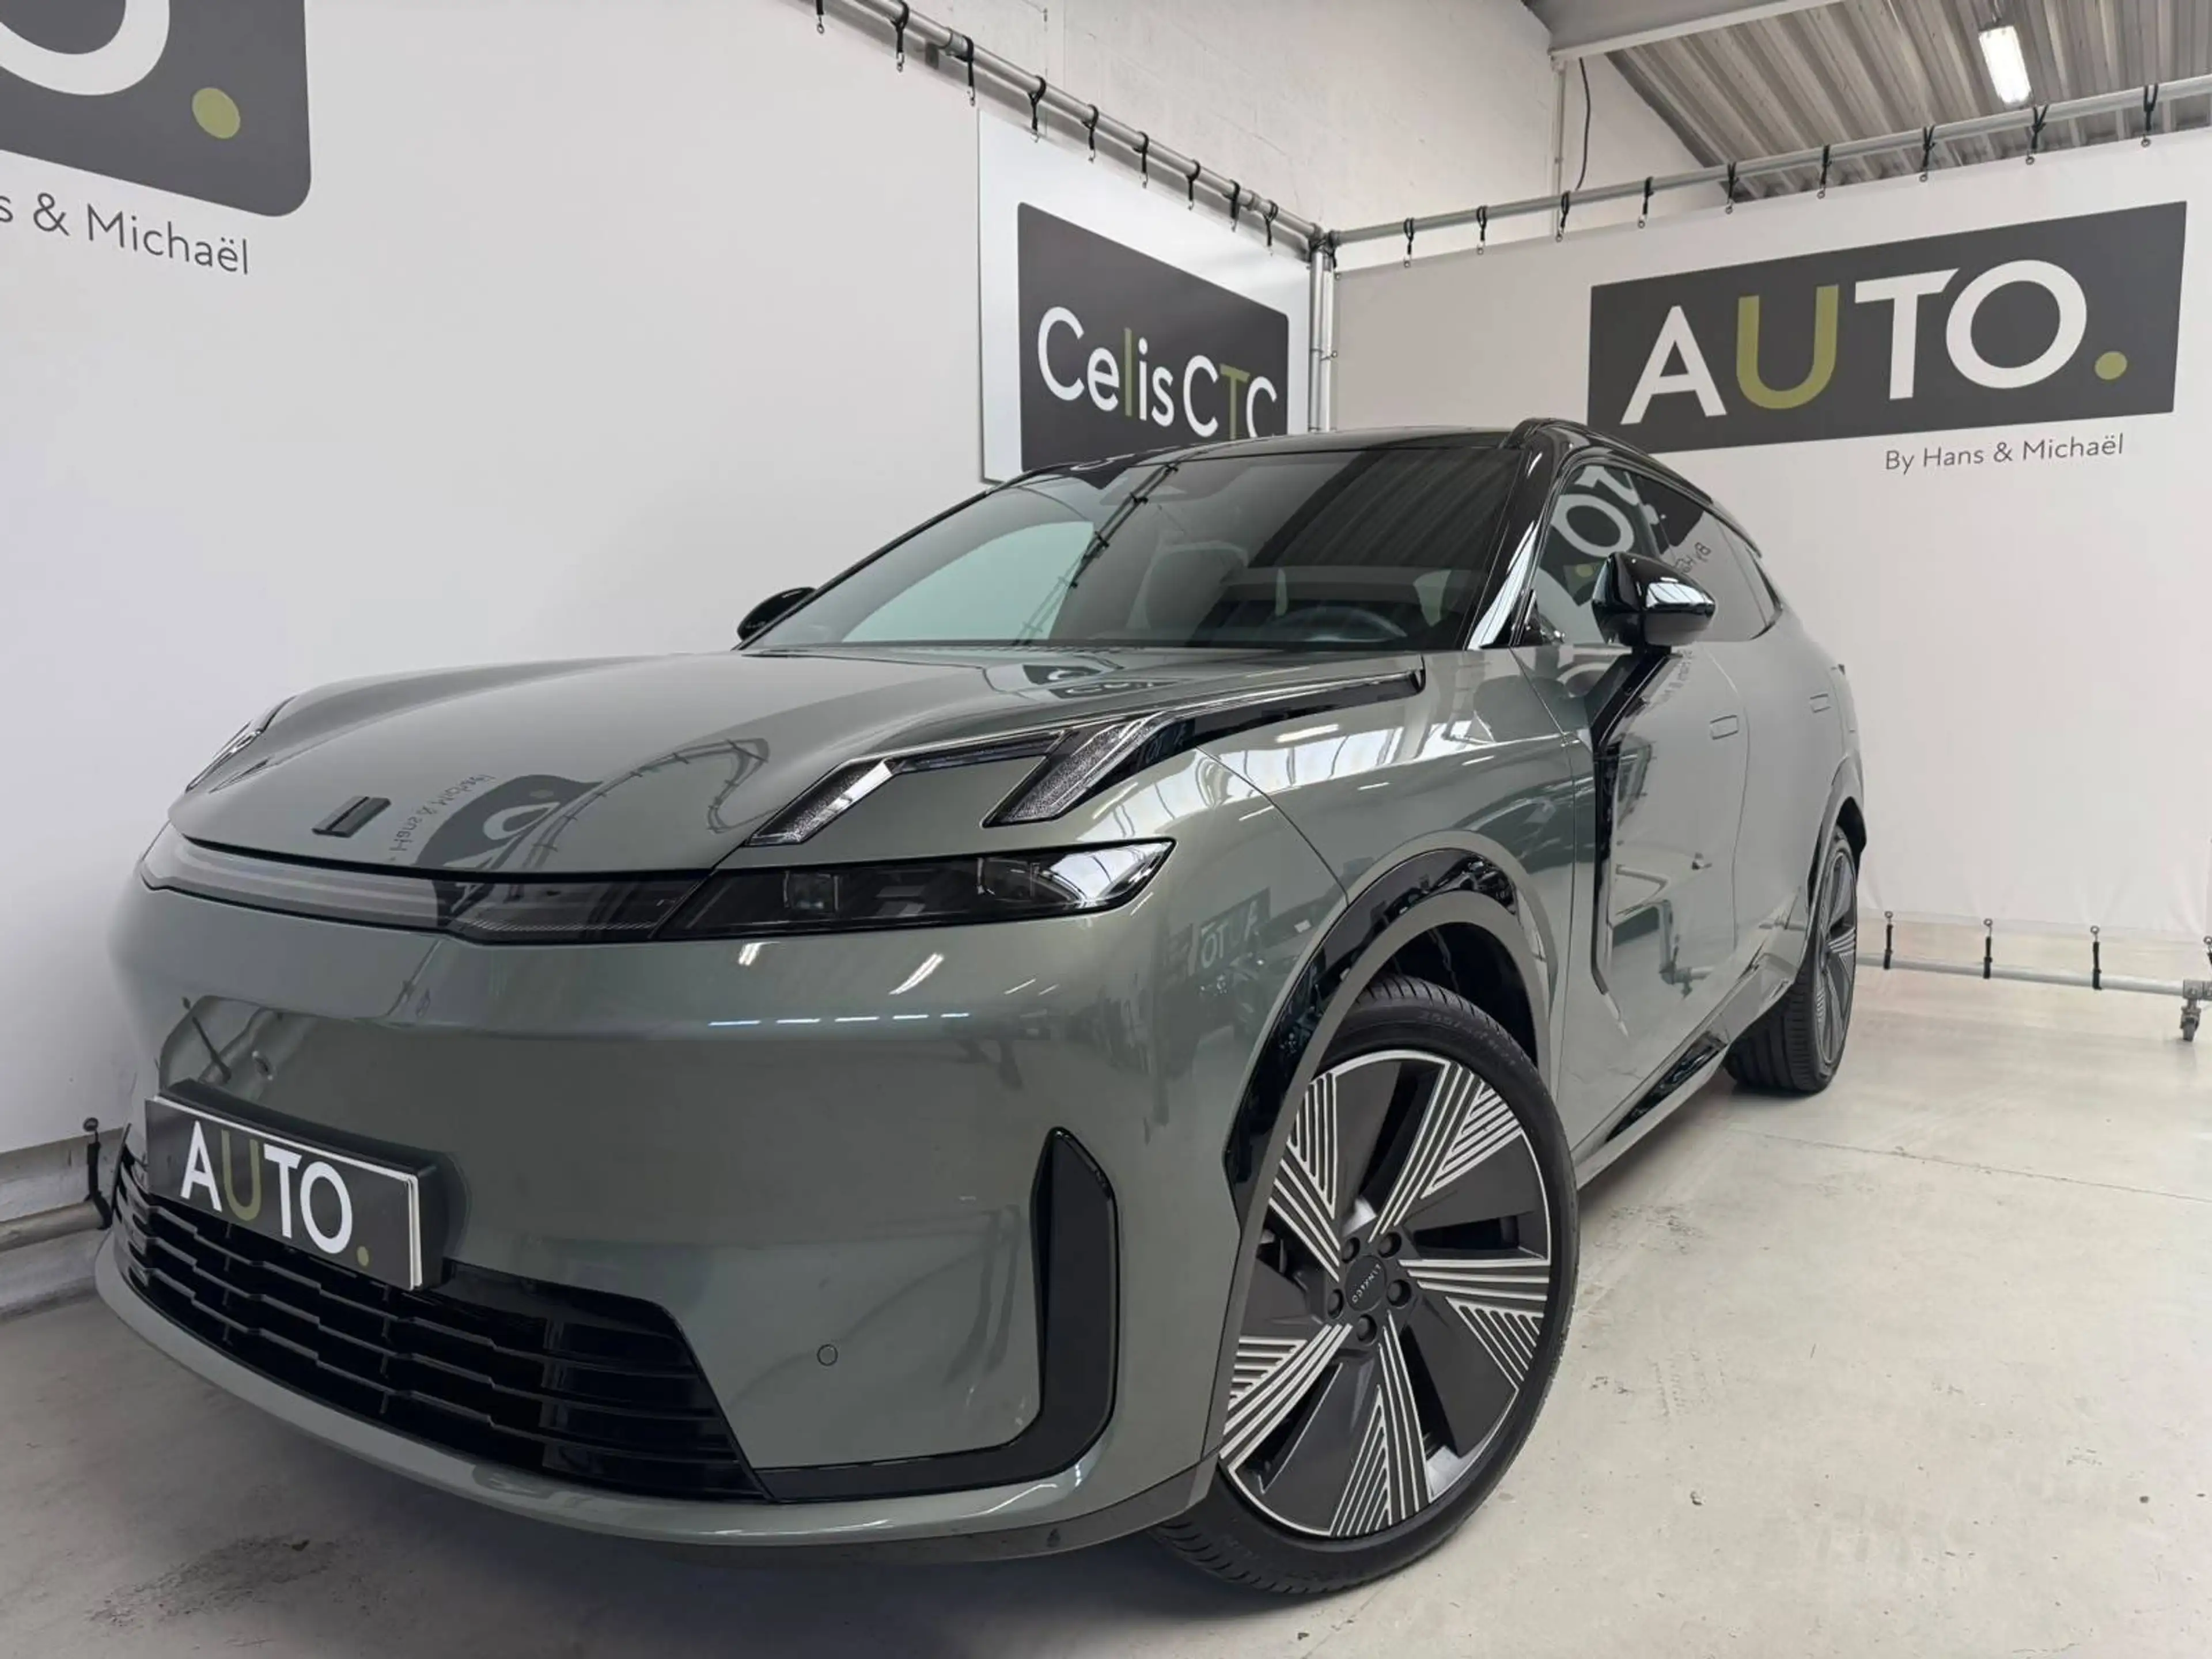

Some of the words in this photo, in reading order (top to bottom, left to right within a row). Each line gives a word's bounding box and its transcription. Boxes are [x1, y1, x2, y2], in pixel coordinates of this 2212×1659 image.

[33, 192, 70, 236] &
[87, 203, 248, 275] Michaël
[1620, 259, 2128, 425] AUTO.
[1885, 449, 1915, 475] By
[1923, 446, 1984, 468] Hans
[1993, 441, 2014, 463] &
[2022, 433, 2124, 460] Michaël
[180, 1120, 369, 1267] AUTO.
